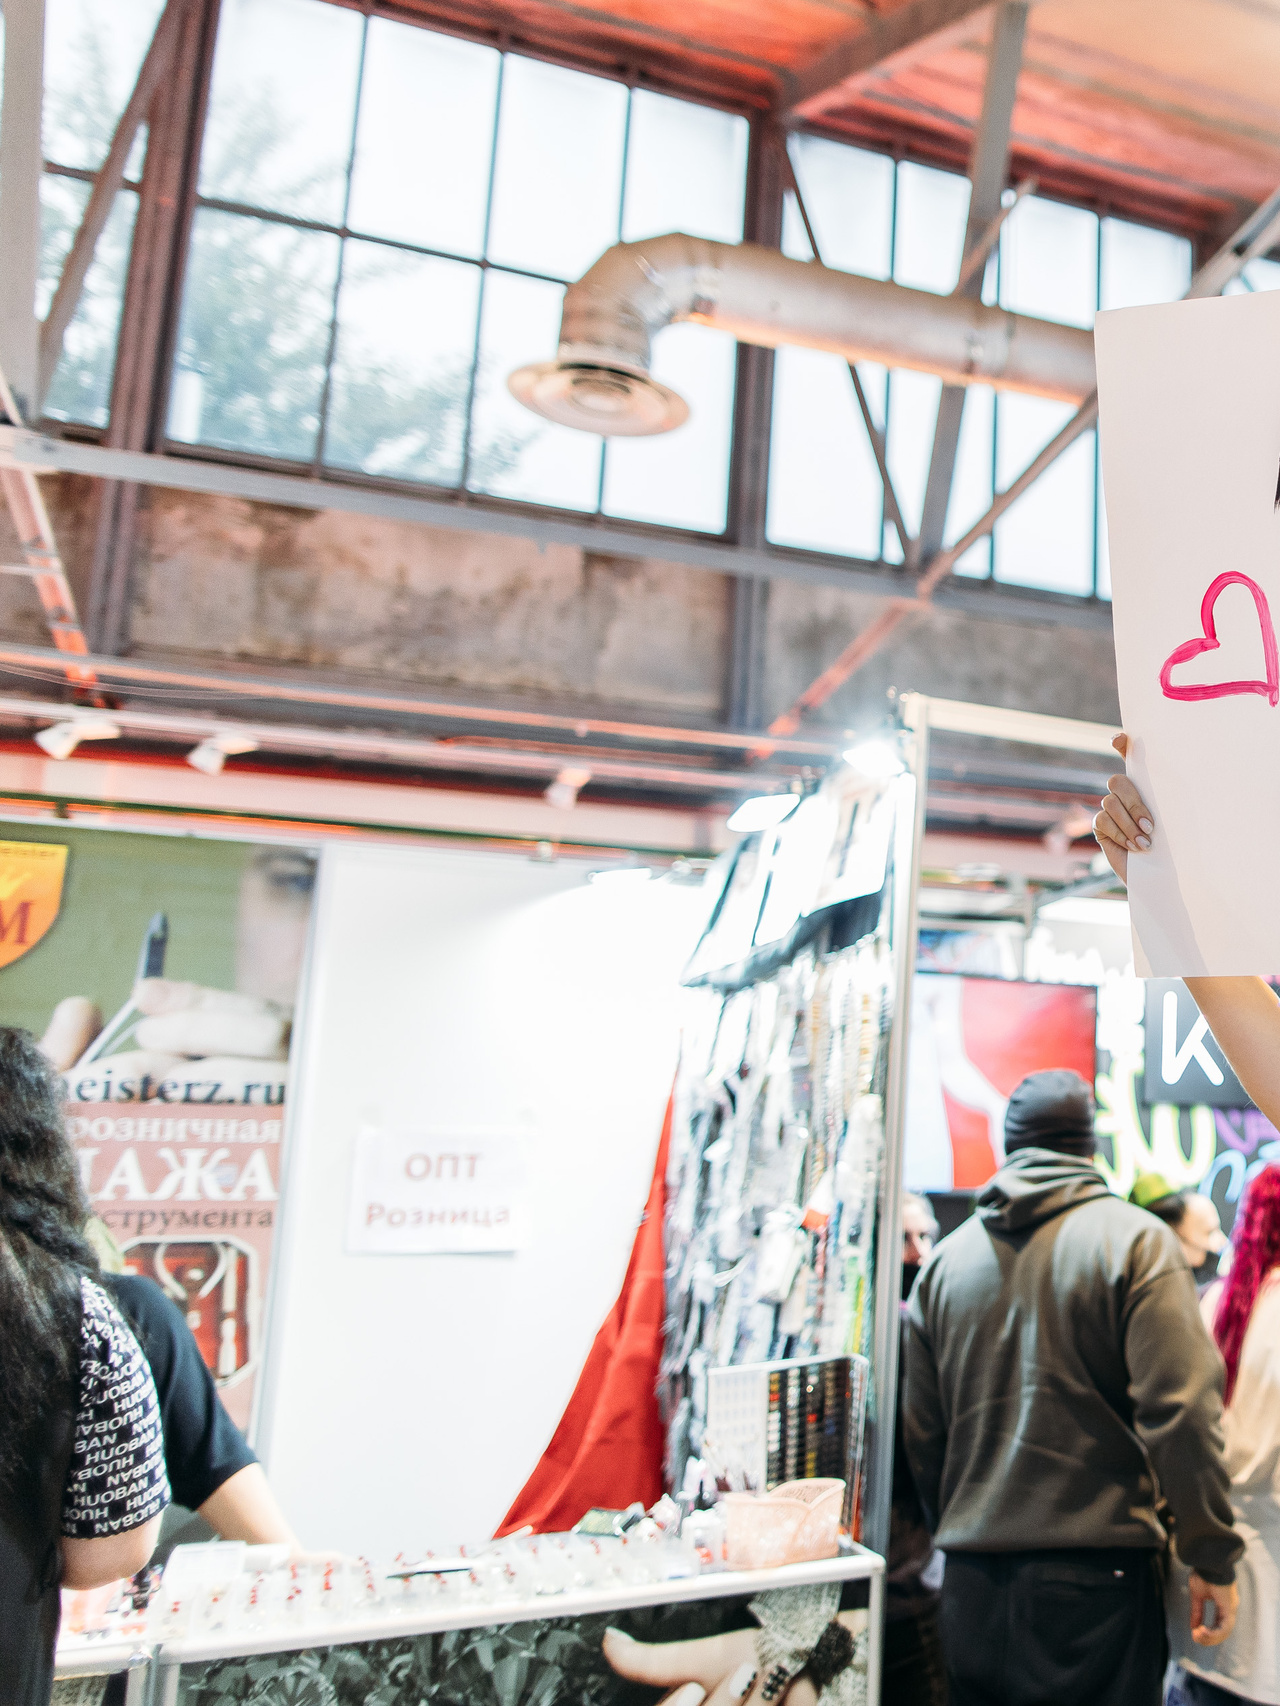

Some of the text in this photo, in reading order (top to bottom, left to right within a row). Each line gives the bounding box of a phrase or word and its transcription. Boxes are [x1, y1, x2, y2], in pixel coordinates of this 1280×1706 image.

[74, 1069, 285, 1106] eisterz.ru
[404, 1153, 482, 1181] ОПТ
[366, 1202, 510, 1228] Розница
